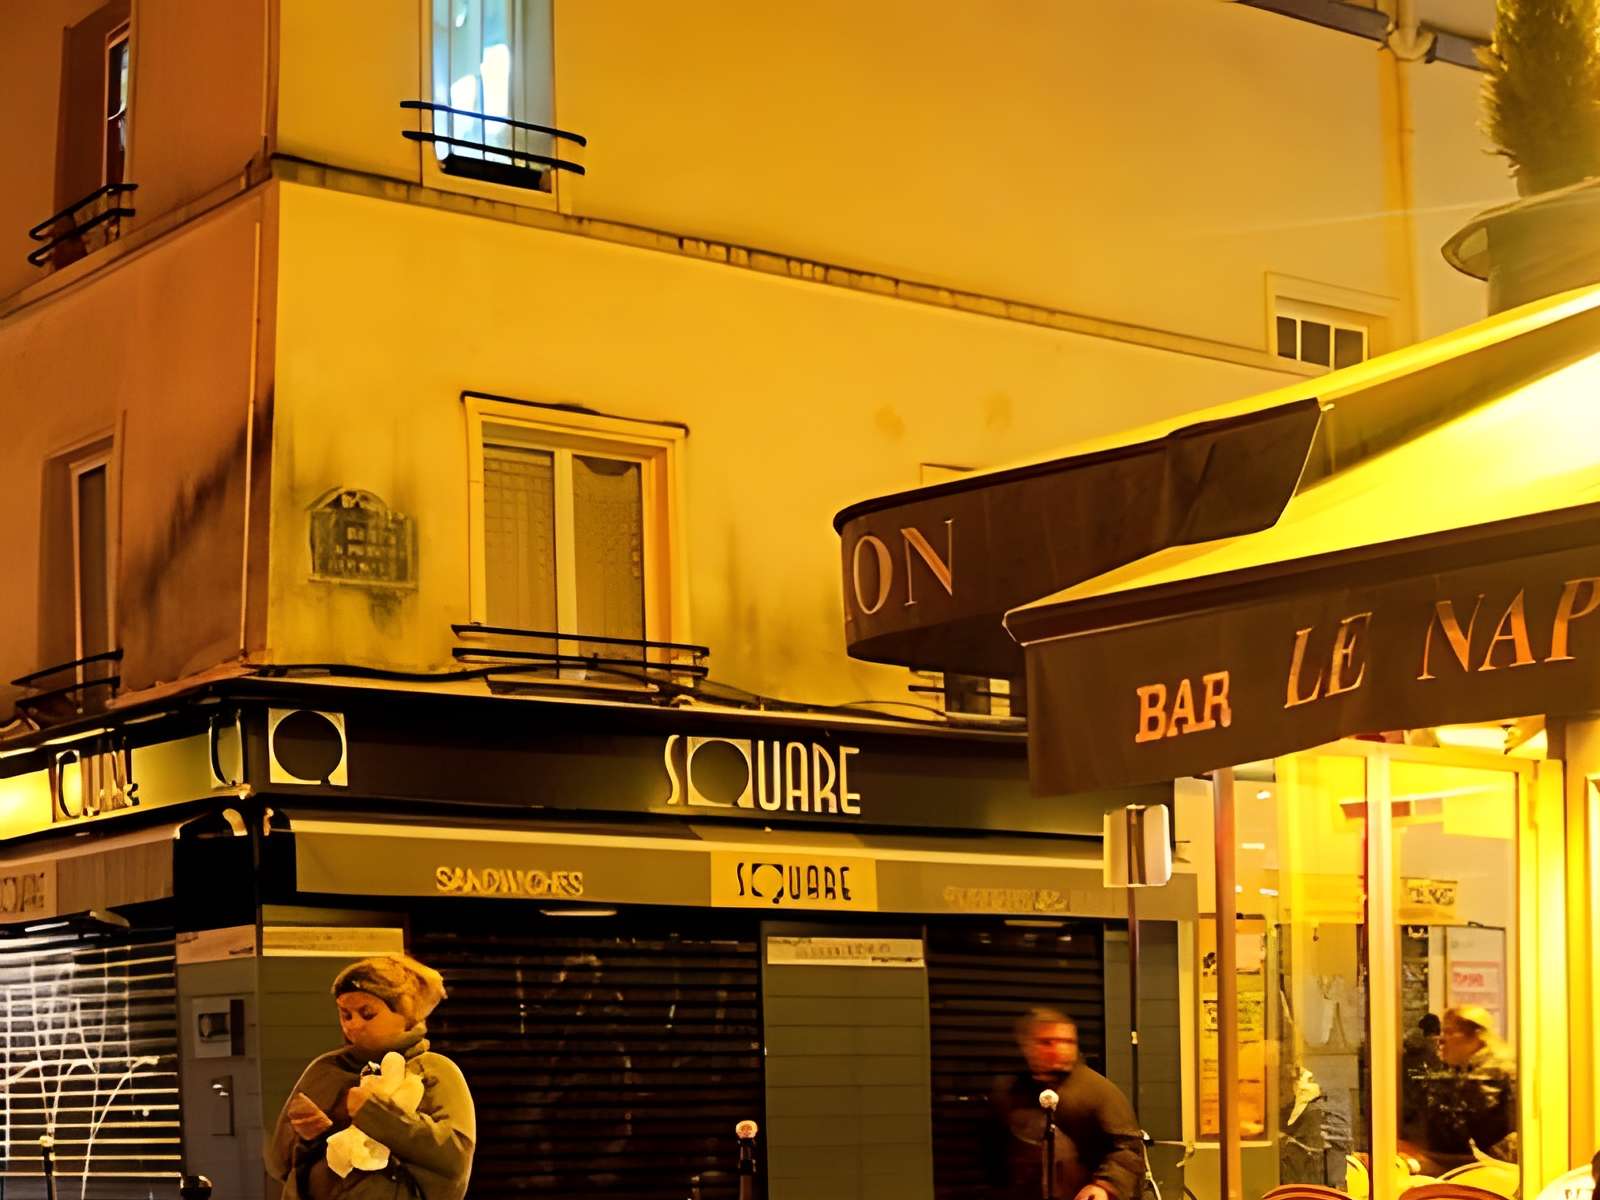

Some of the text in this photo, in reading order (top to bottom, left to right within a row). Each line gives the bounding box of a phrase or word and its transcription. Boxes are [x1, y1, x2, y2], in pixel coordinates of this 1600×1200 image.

[852, 518, 956, 615] ON
[1134, 669, 1232, 744] BAR
[1284, 611, 1372, 709] LE
[664, 734, 861, 815] SQUARE
[736, 862, 852, 904] SQUARE
